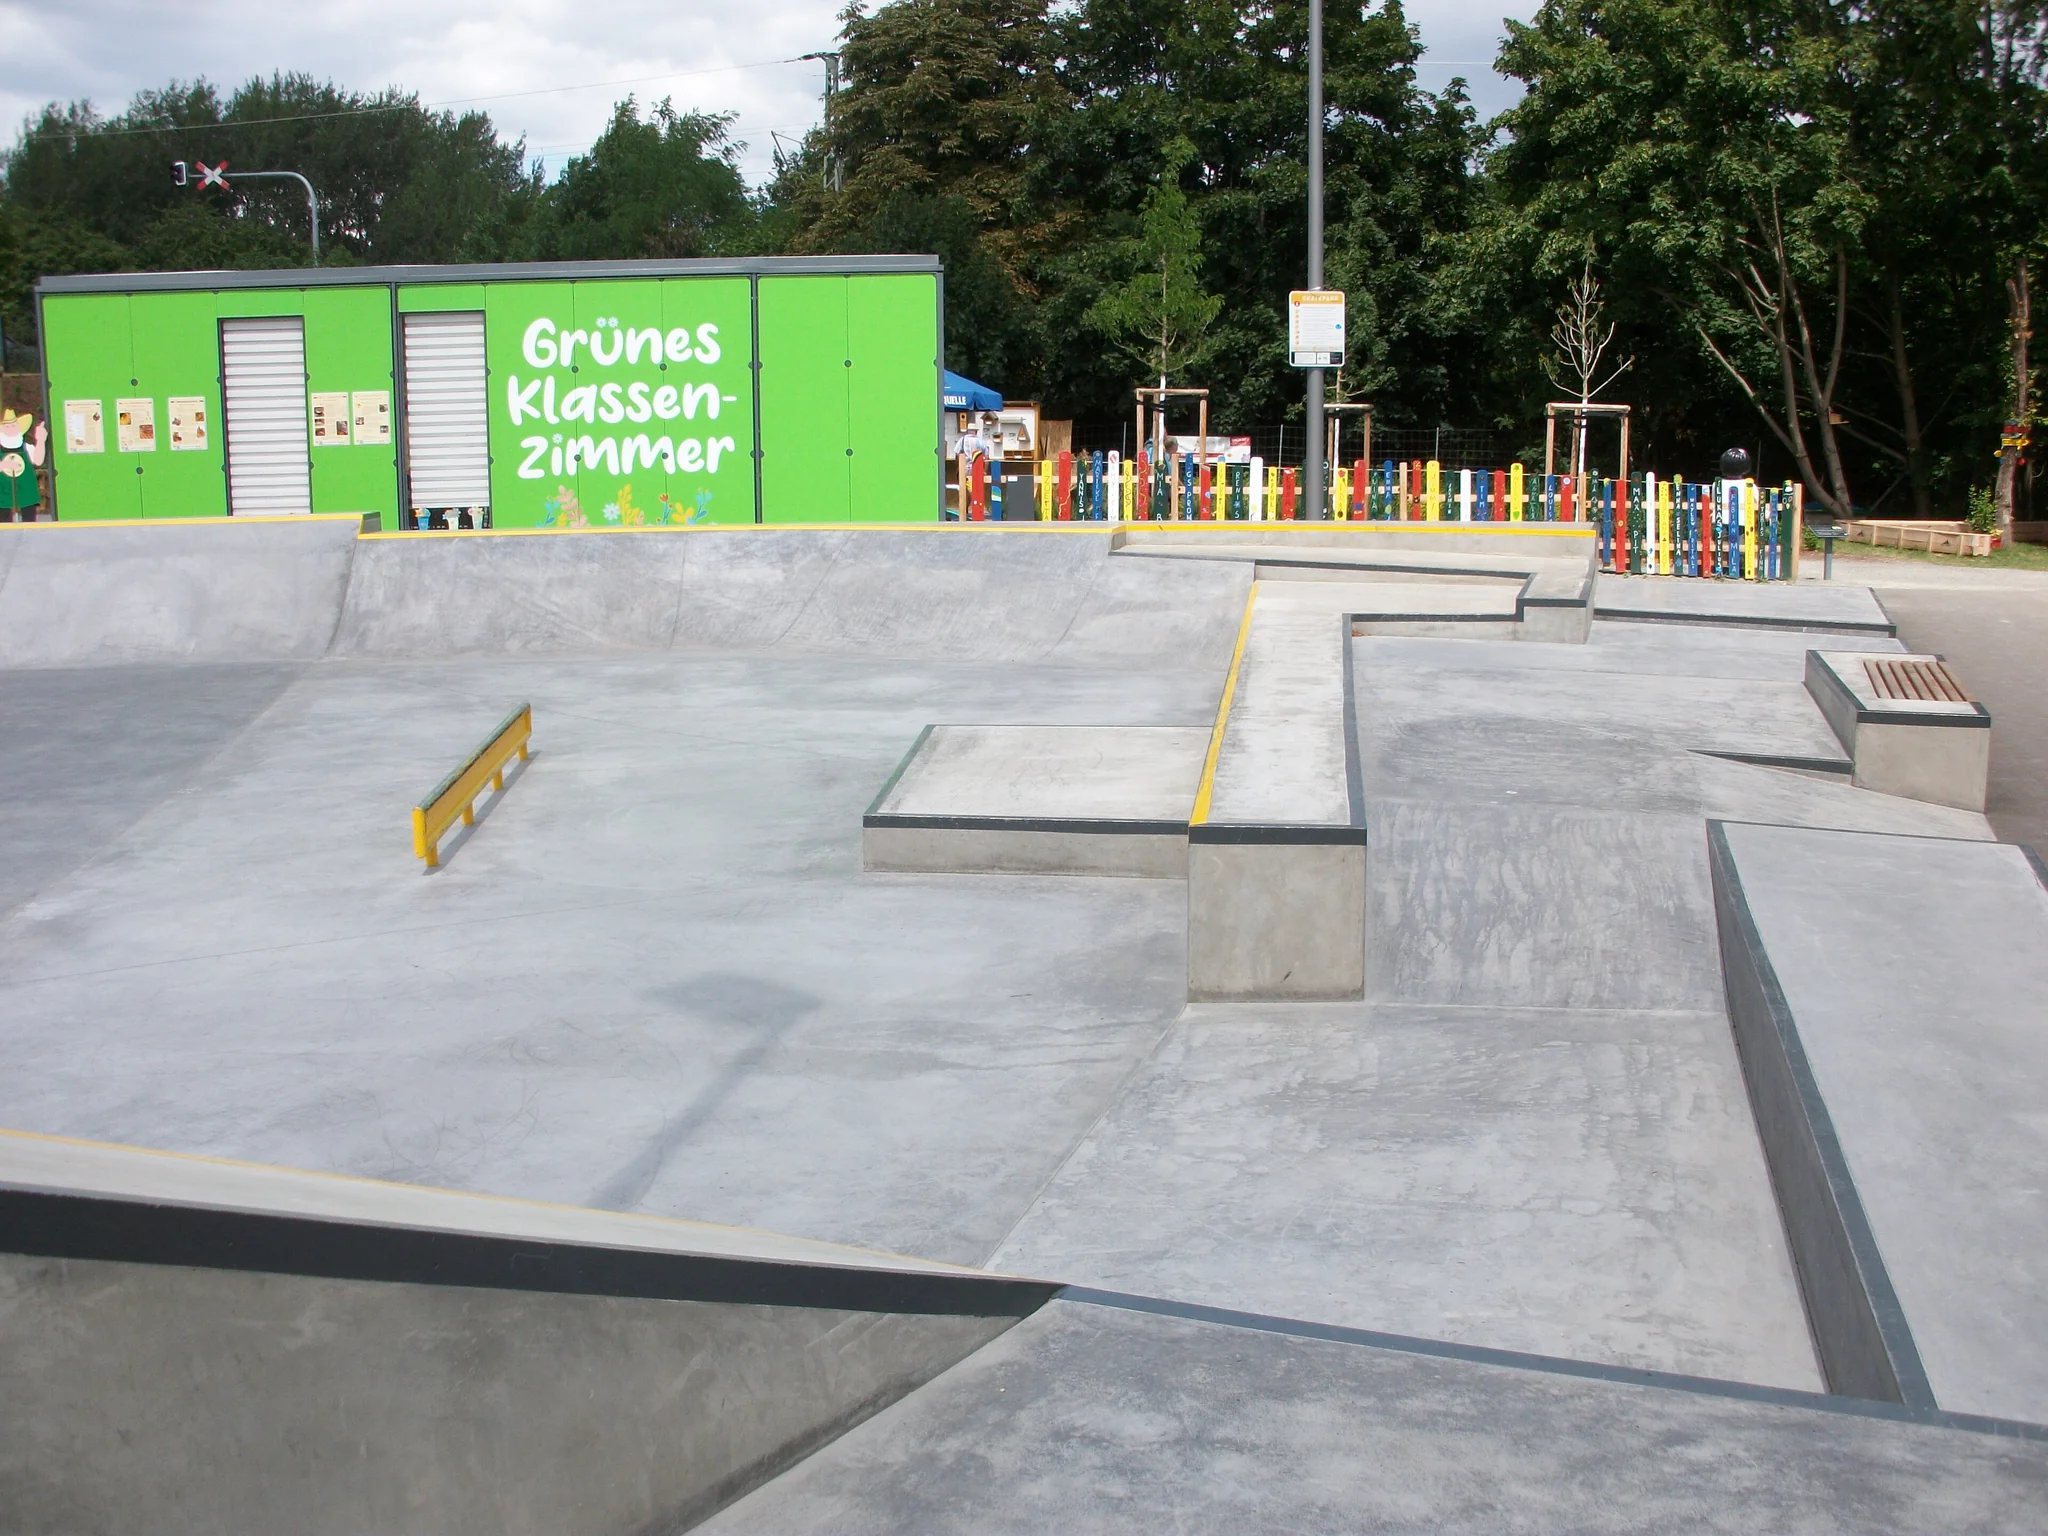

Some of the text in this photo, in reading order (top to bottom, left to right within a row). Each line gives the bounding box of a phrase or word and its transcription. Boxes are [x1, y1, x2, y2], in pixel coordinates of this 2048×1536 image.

[522, 317, 721, 368] Grünes
[507, 375, 738, 426] Klassen-
[1632, 487, 1640, 511] MAX
[1730, 542, 1738, 573] MILA
